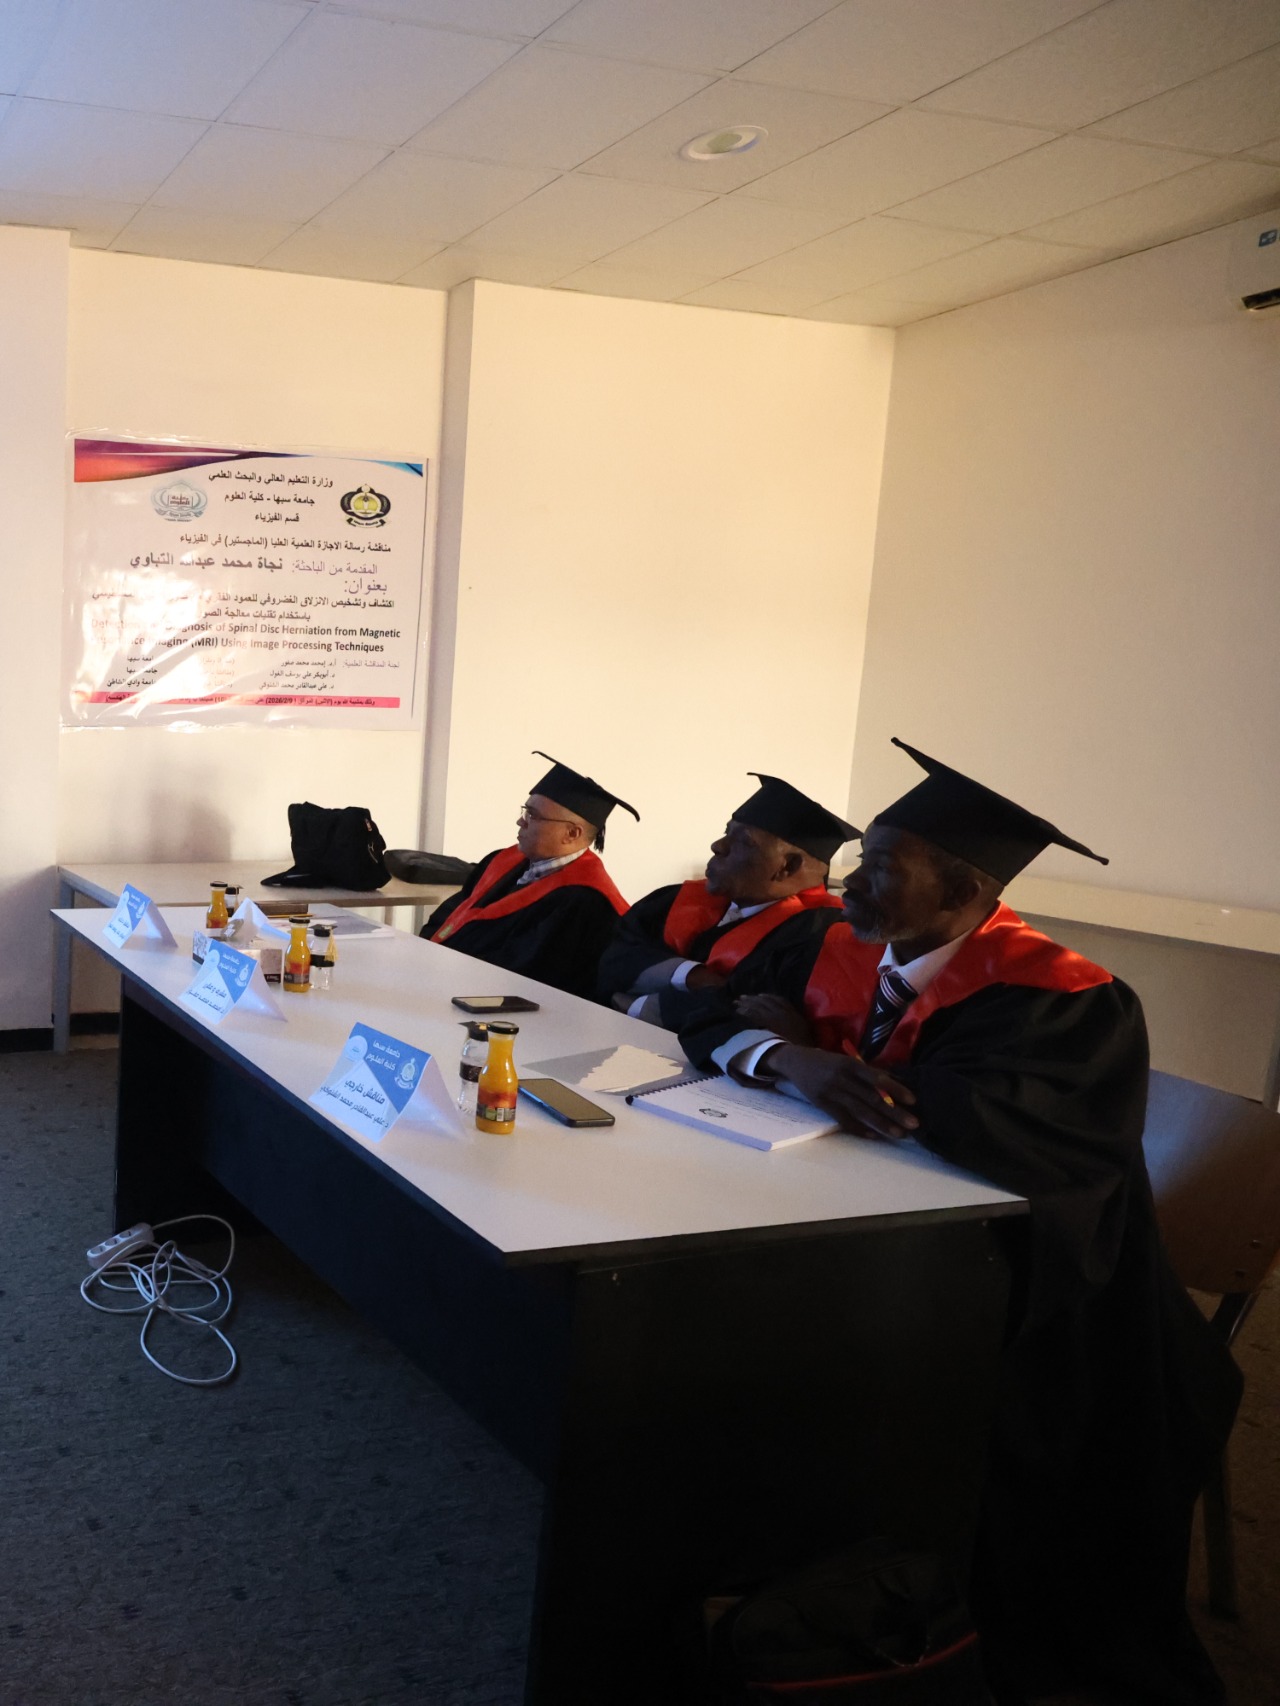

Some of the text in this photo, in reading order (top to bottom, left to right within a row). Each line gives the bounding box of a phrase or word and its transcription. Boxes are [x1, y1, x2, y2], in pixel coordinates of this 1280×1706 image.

[208, 469, 334, 488] وزارة التعليم العالي والبحث العلمي
[224, 491, 247, 503] العلوم
[248, 492, 265, 503] كلية
[273, 493, 292, 505] سبها
[293, 494, 315, 506] جامعة
[254, 512, 300, 524] قسم الفيزياء
[179, 533, 208, 545] الفيزياء
[211, 533, 222, 545] في
[270, 536, 289, 548] العليا
[291, 537, 315, 550] العلمية
[344, 540, 365, 553] رسالة
[367, 540, 391, 552] مناقشة
[222, 557, 252, 568] محمد
[257, 557, 283, 572] نجاة
[329, 563, 343, 576] من
[346, 562, 378, 576] المقدمة
[344, 577, 387, 594] بعنوان:
[234, 593, 258, 604] للعمود
[259, 593, 297, 606] الغضروفي
[331, 597, 366, 609] وتشخيص
[224, 607, 251, 619] معالجة
[277, 611, 311, 623] باستخدام
[215, 622, 226, 632] of
[228, 622, 258, 634] Spinal
[260, 623, 280, 634] Disc
[282, 624, 332, 636] Herniation
[334, 625, 358, 637] from
[359, 627, 401, 640] Magnetic
[221, 637, 248, 649] Using
[250, 639, 279, 651] Image
[282, 640, 333, 653] Processing
[334, 641, 384, 653] Techniques
[362, 1087, 386, 1105] مناقش
